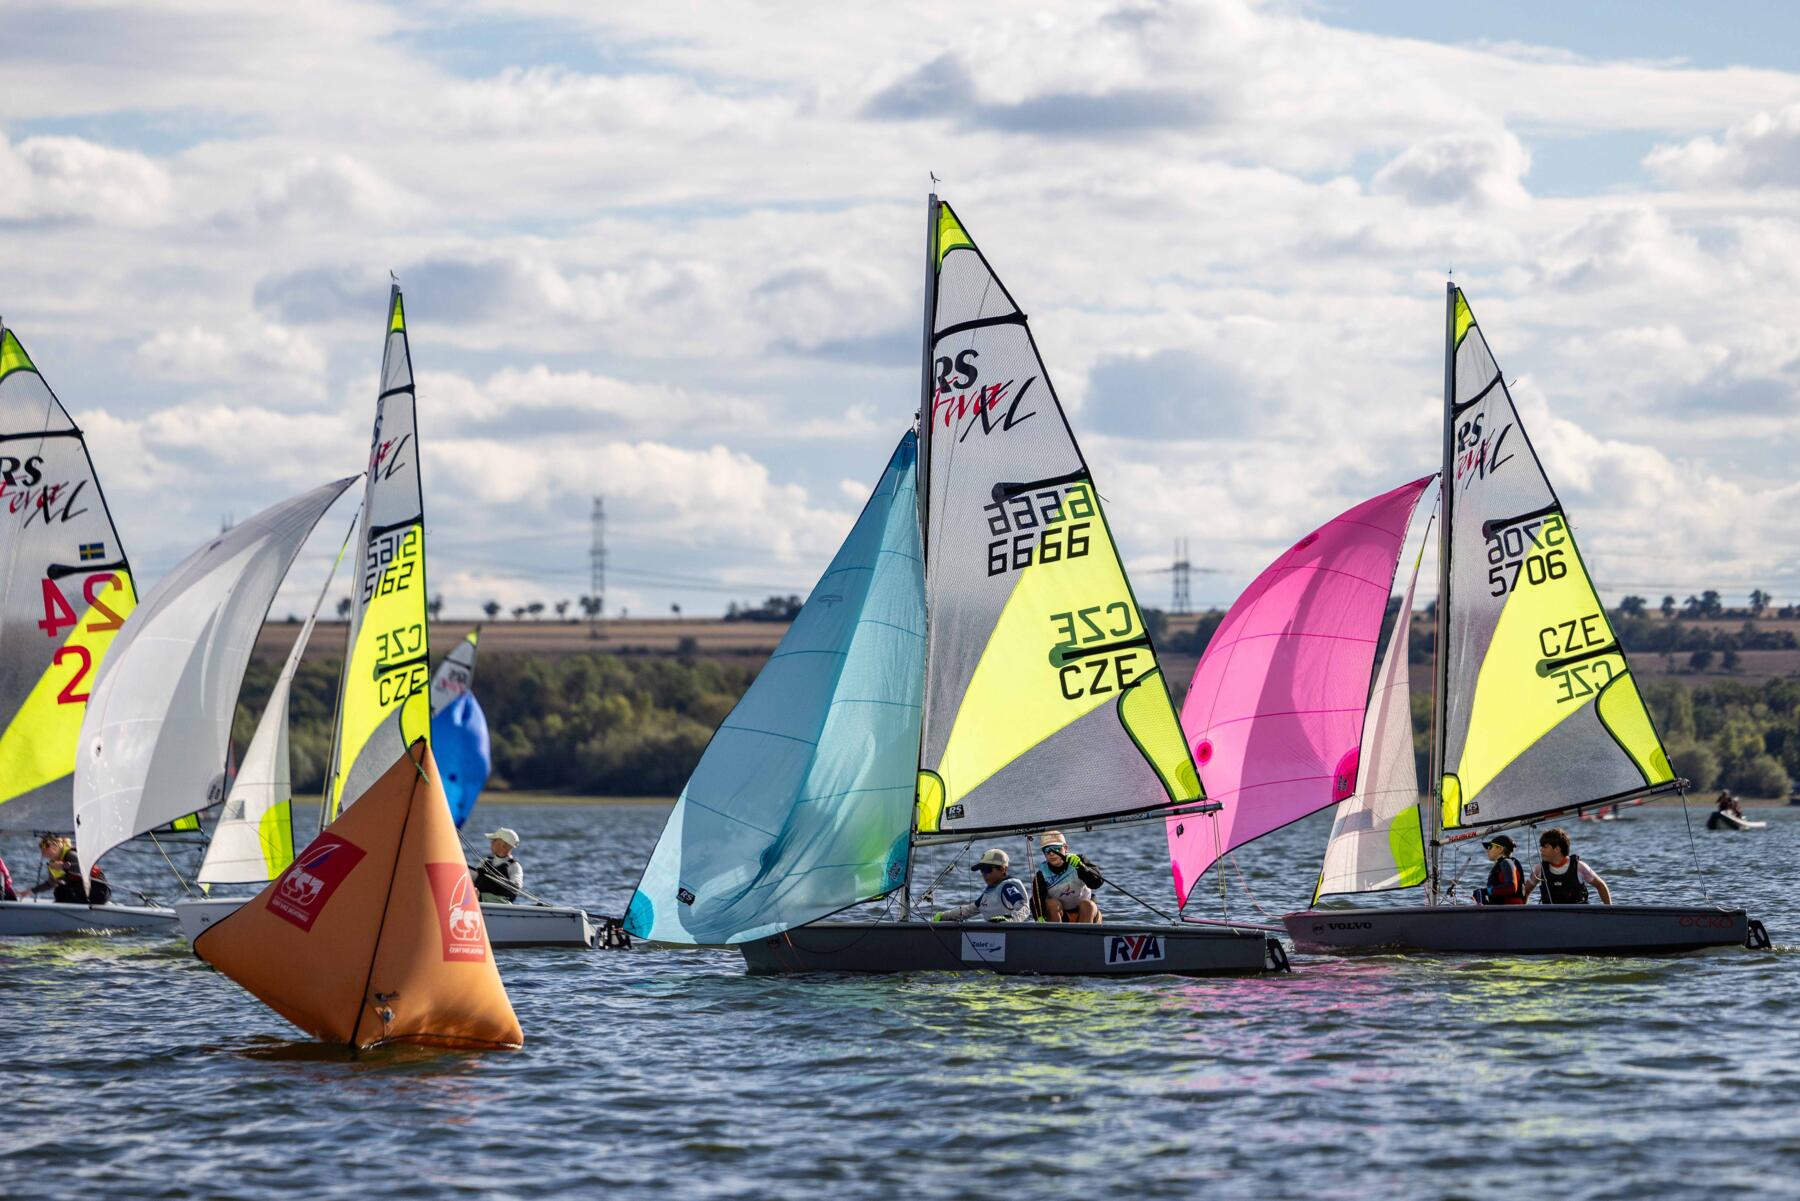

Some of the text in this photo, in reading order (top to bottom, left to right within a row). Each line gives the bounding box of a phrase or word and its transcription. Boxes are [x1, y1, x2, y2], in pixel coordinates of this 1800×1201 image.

[935, 349, 979, 393] RS
[959, 376, 1038, 443] XL
[1457, 412, 1485, 454] RS
[0, 456, 44, 487] RS
[1465, 422, 1515, 490] XL
[23, 480, 88, 529] XL
[988, 522, 1090, 577] 6666
[363, 561, 415, 604] 5162
[1488, 549, 1567, 597] 5706
[1539, 614, 1605, 657] CZE
[53, 645, 92, 705] 2
[379, 667, 425, 707] CZE
[1058, 653, 1141, 700] CZE
[1328, 921, 1373, 930] VOLVO
[1109, 934, 1162, 962] RYA
